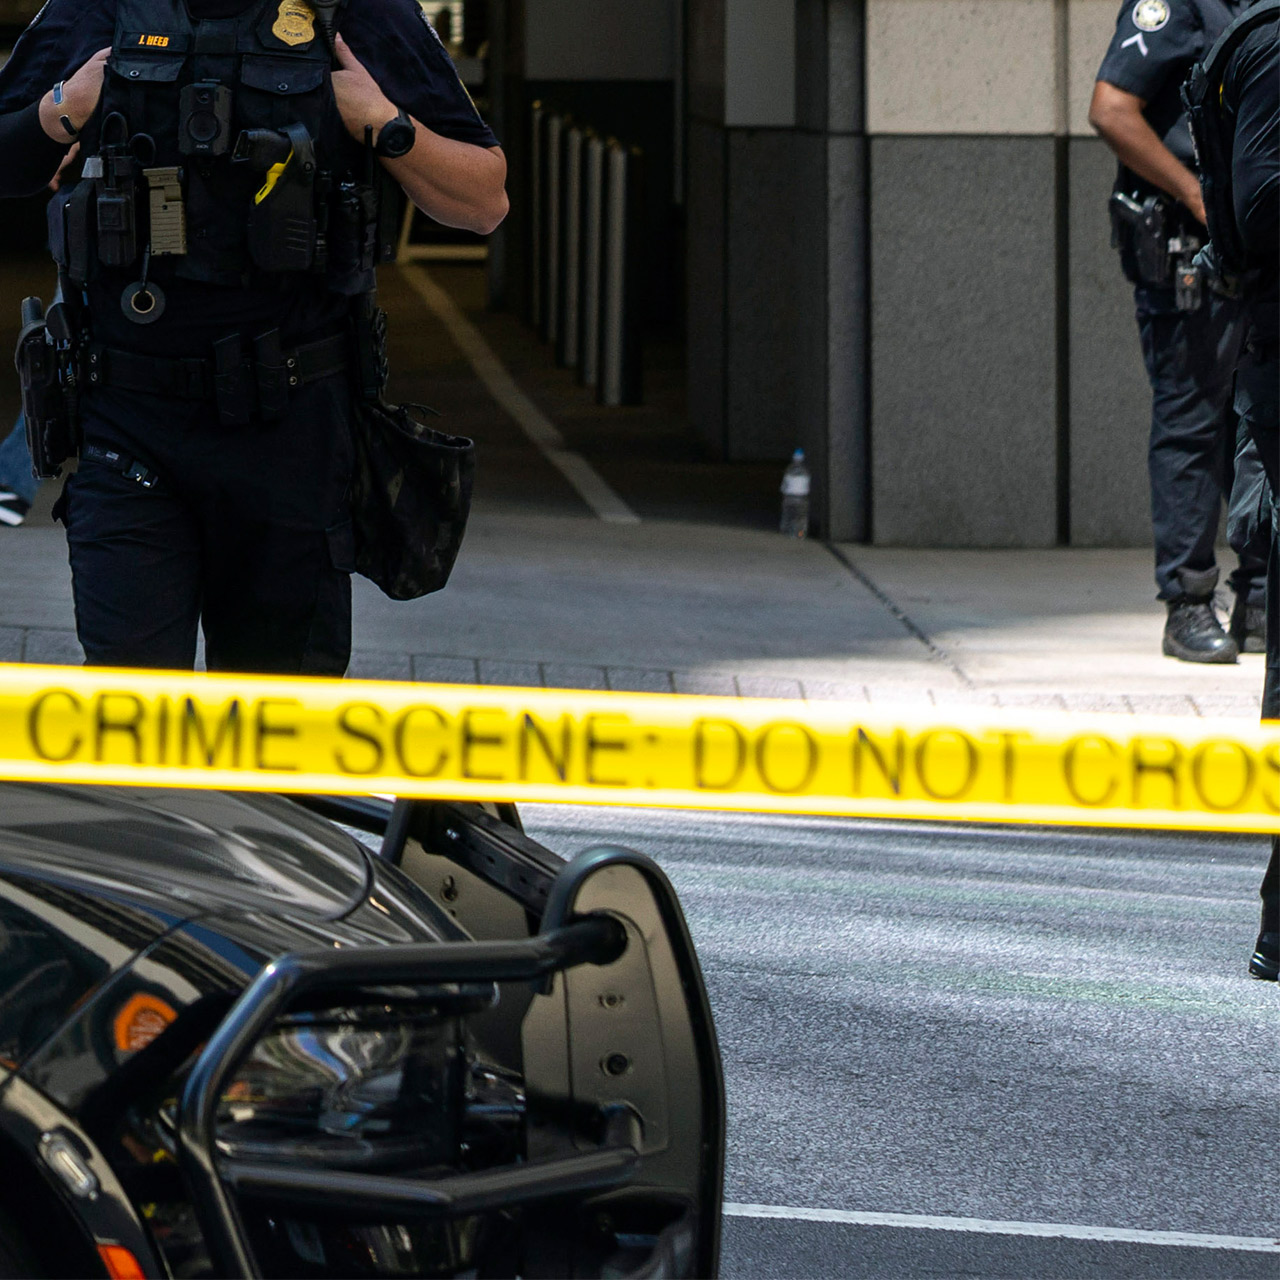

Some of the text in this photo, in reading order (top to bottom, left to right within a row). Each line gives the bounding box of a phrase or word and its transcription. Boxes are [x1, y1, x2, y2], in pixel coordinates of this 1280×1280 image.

[27, 687, 302, 772] CRIME
[334, 701, 660, 789] SCENE:
[692, 716, 819, 794] DO
[851, 726, 1033, 801] NOT
